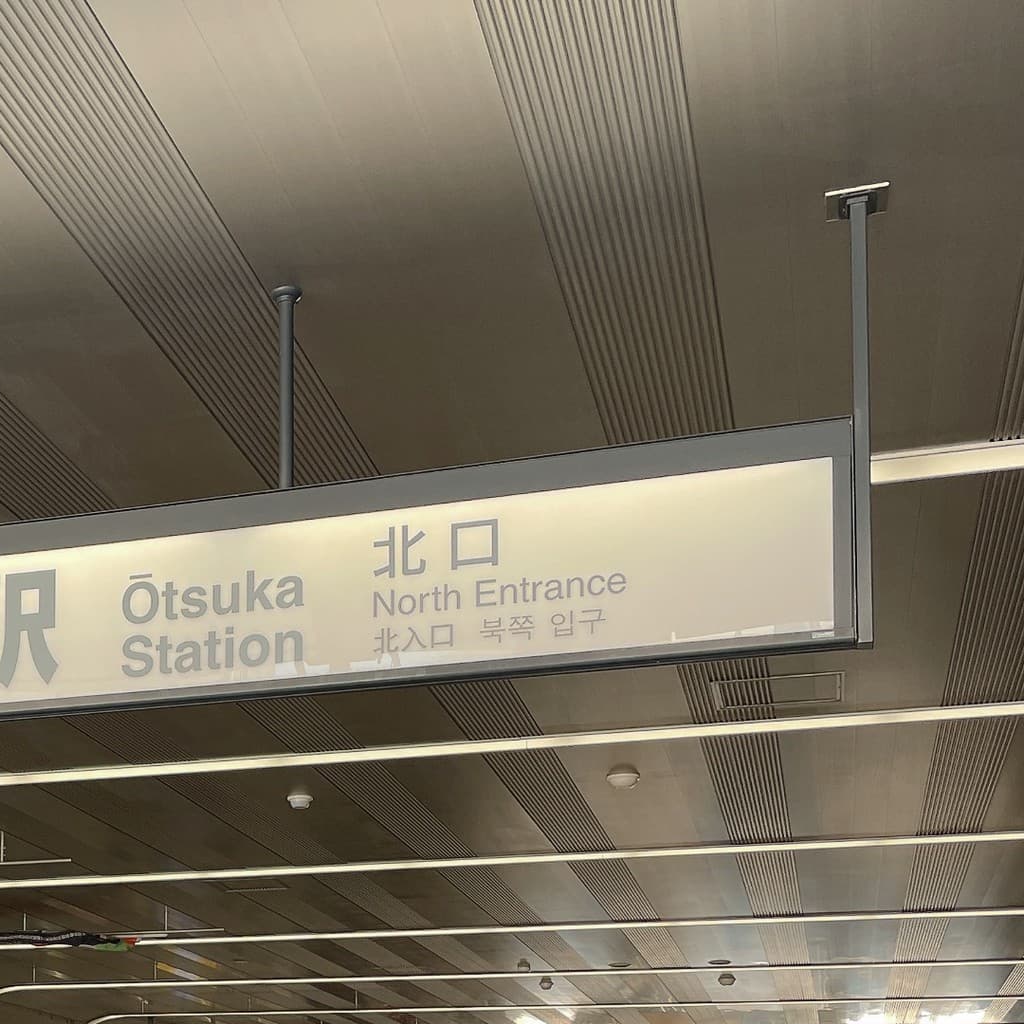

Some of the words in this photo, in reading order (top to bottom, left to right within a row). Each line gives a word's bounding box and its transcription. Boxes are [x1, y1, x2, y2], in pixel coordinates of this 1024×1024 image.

[373, 518, 500, 579] 北口
[121, 570, 305, 626] Ōtsuka
[372, 583, 461, 618] North
[474, 568, 628, 607] Entrance
[373, 623, 454, 655] 北入口
[479, 613, 535, 645] 북쪽
[550, 608, 607, 639] 입구
[121, 628, 305, 678] Station
